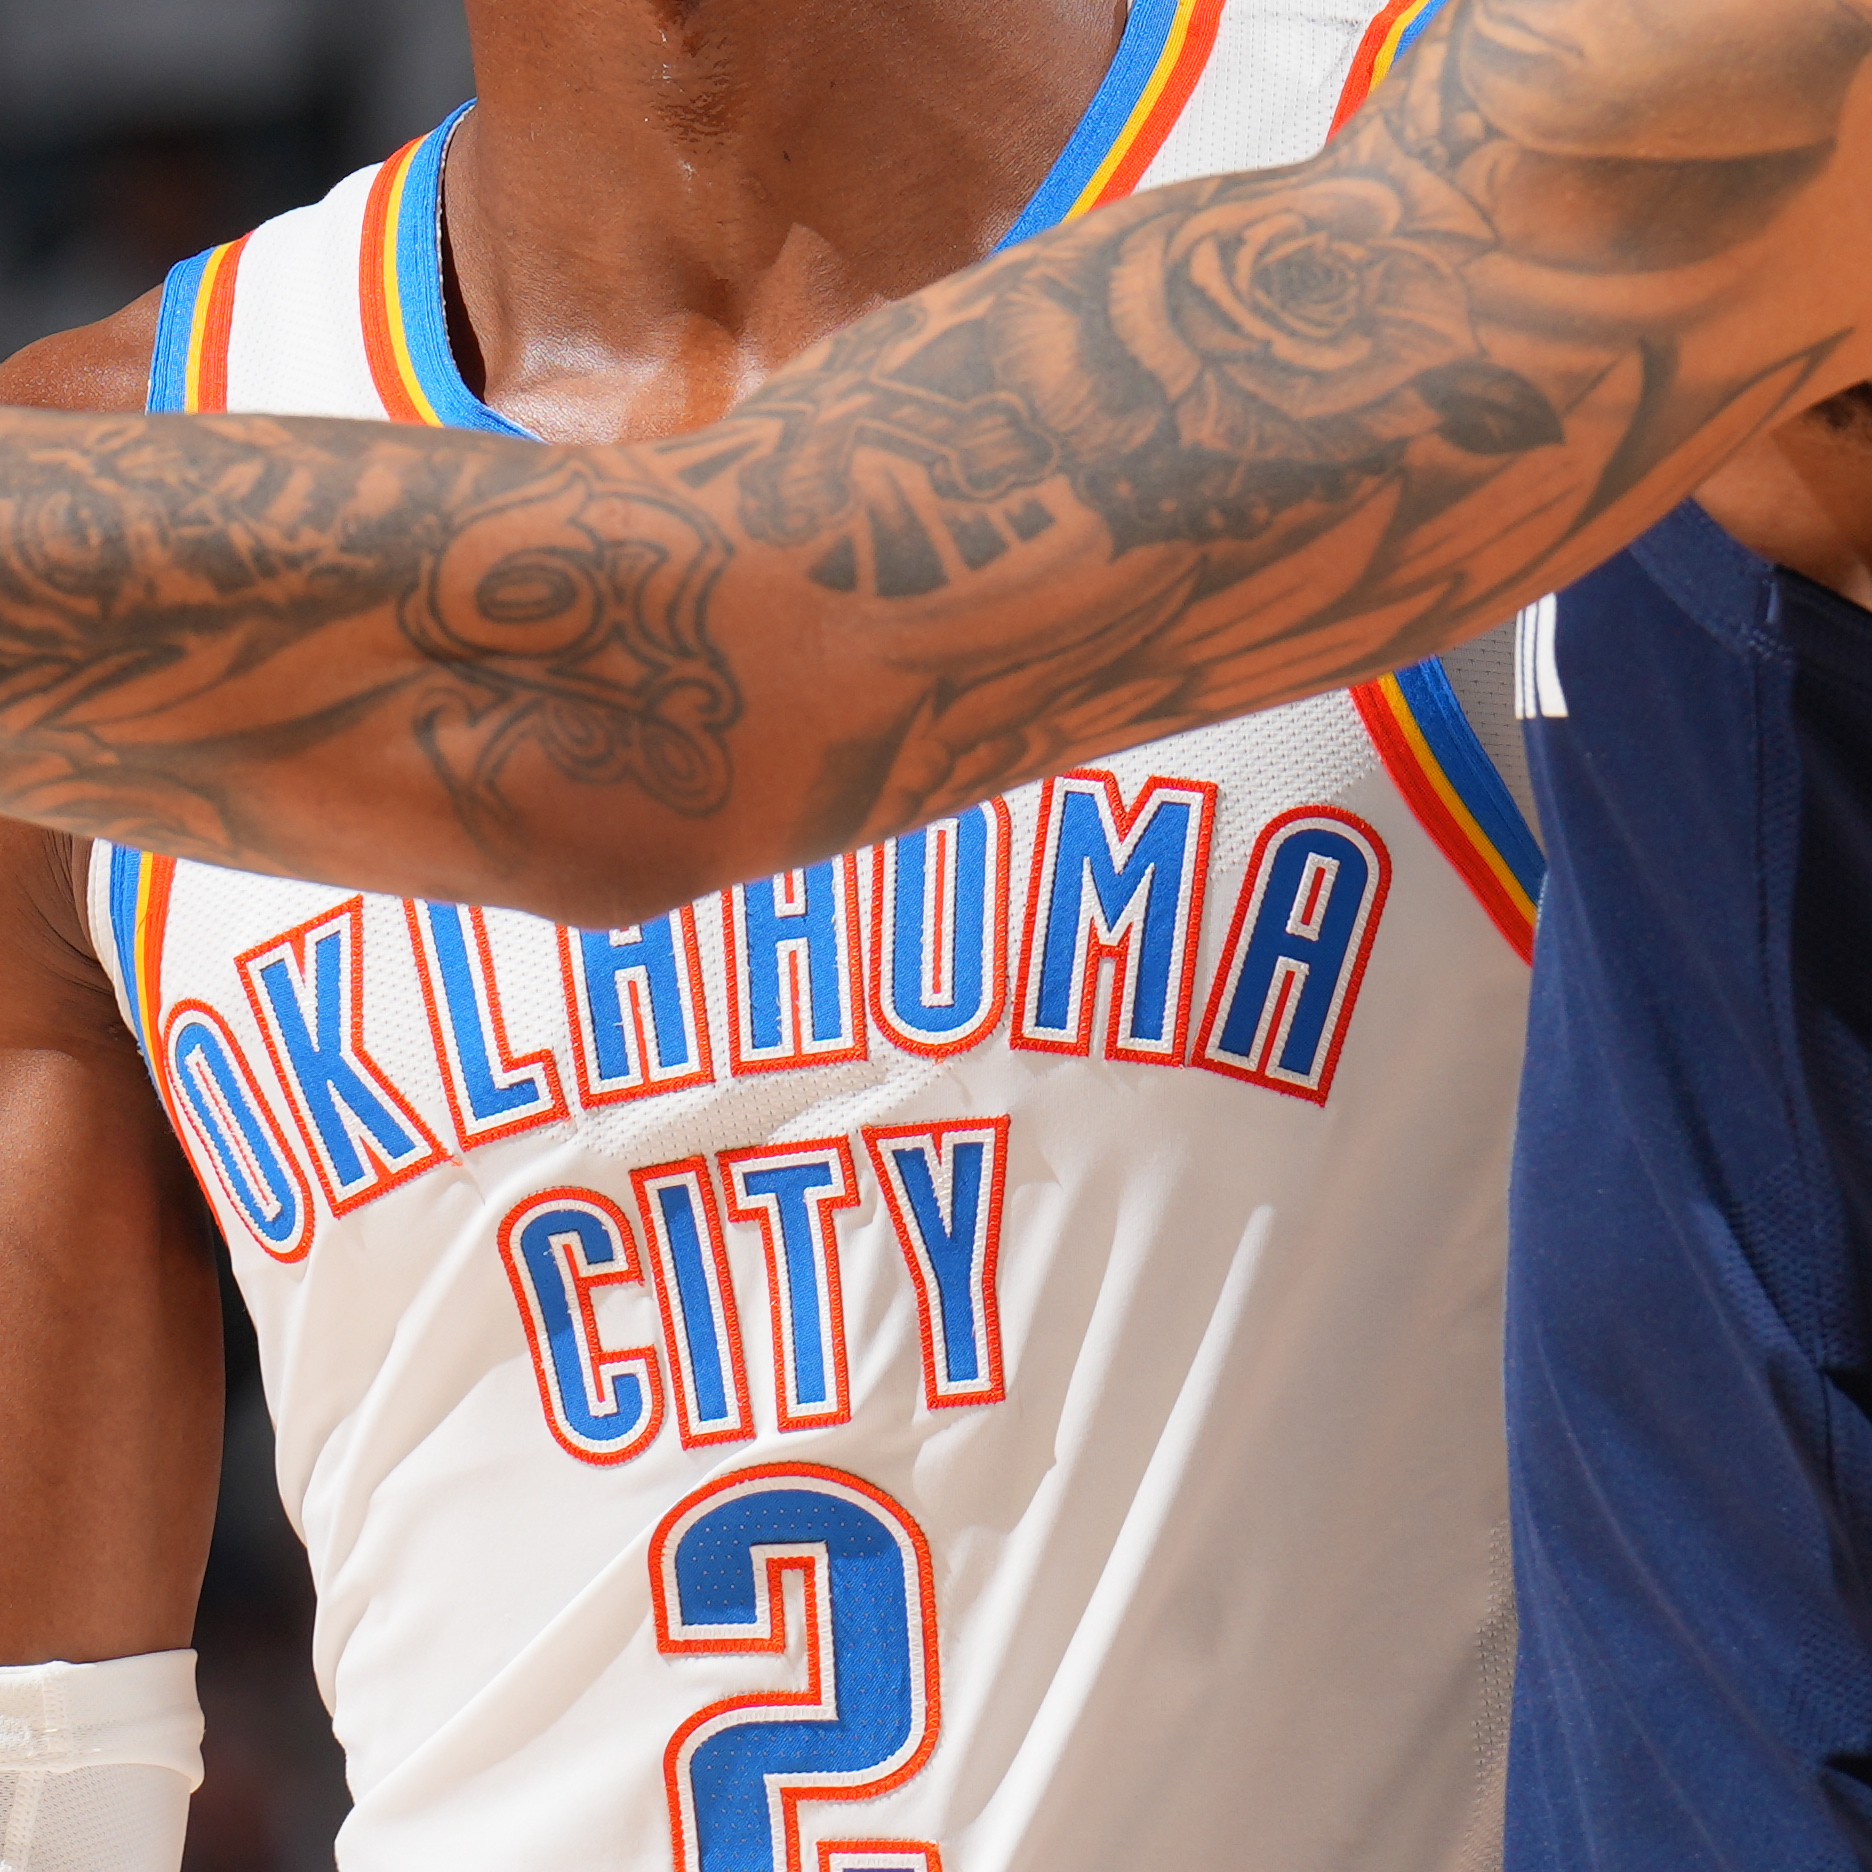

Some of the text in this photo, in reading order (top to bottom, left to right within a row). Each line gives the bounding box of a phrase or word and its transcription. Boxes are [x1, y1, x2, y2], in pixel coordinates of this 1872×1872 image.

[159, 769, 1392, 1264] OKLAHOMA
[497, 1116, 1011, 1466] CITY
[647, 1461, 943, 1872] 2
